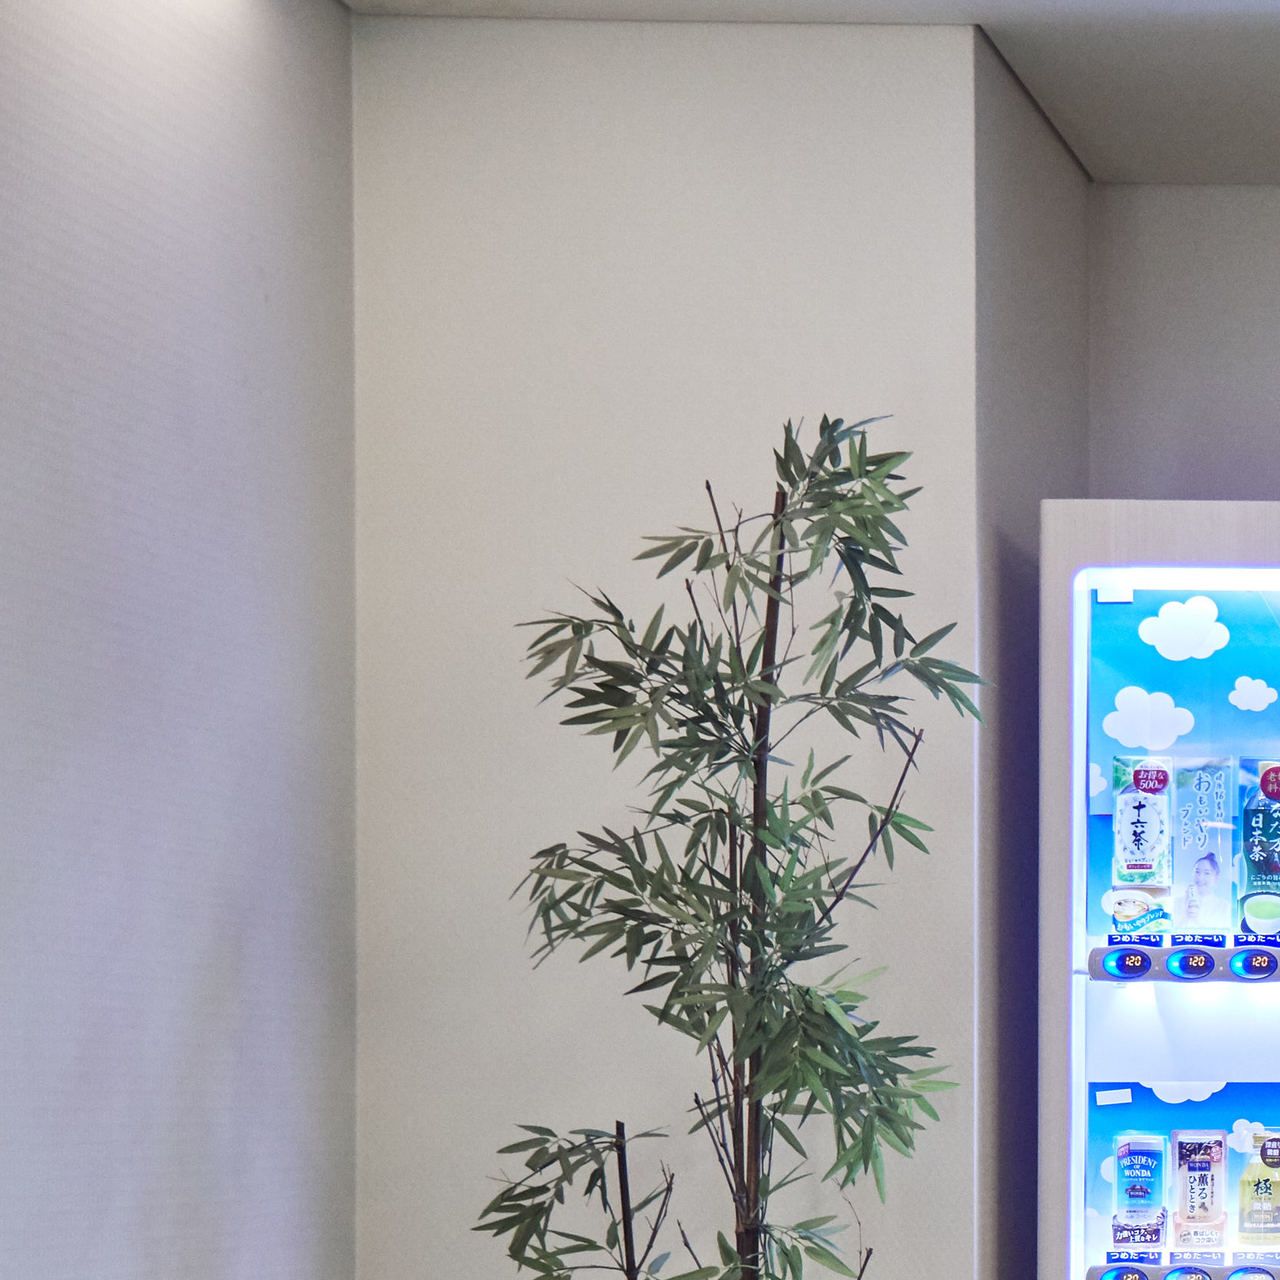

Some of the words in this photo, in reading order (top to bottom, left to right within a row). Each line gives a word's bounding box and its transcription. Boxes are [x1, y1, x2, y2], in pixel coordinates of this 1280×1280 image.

[1138, 770, 1165, 780] お得な
[1130, 801, 1149, 850] 十六茶
[1250, 813, 1267, 862] 日本茶
[1126, 956, 1142, 966] 120
[1118, 1156, 1158, 1169] PRESIDENT
[1124, 1168, 1152, 1177] WONDA
[1188, 1175, 1197, 1214] ひととき
[1198, 1174, 1208, 1200] 薫る
[1253, 1178, 1274, 1196] 極
